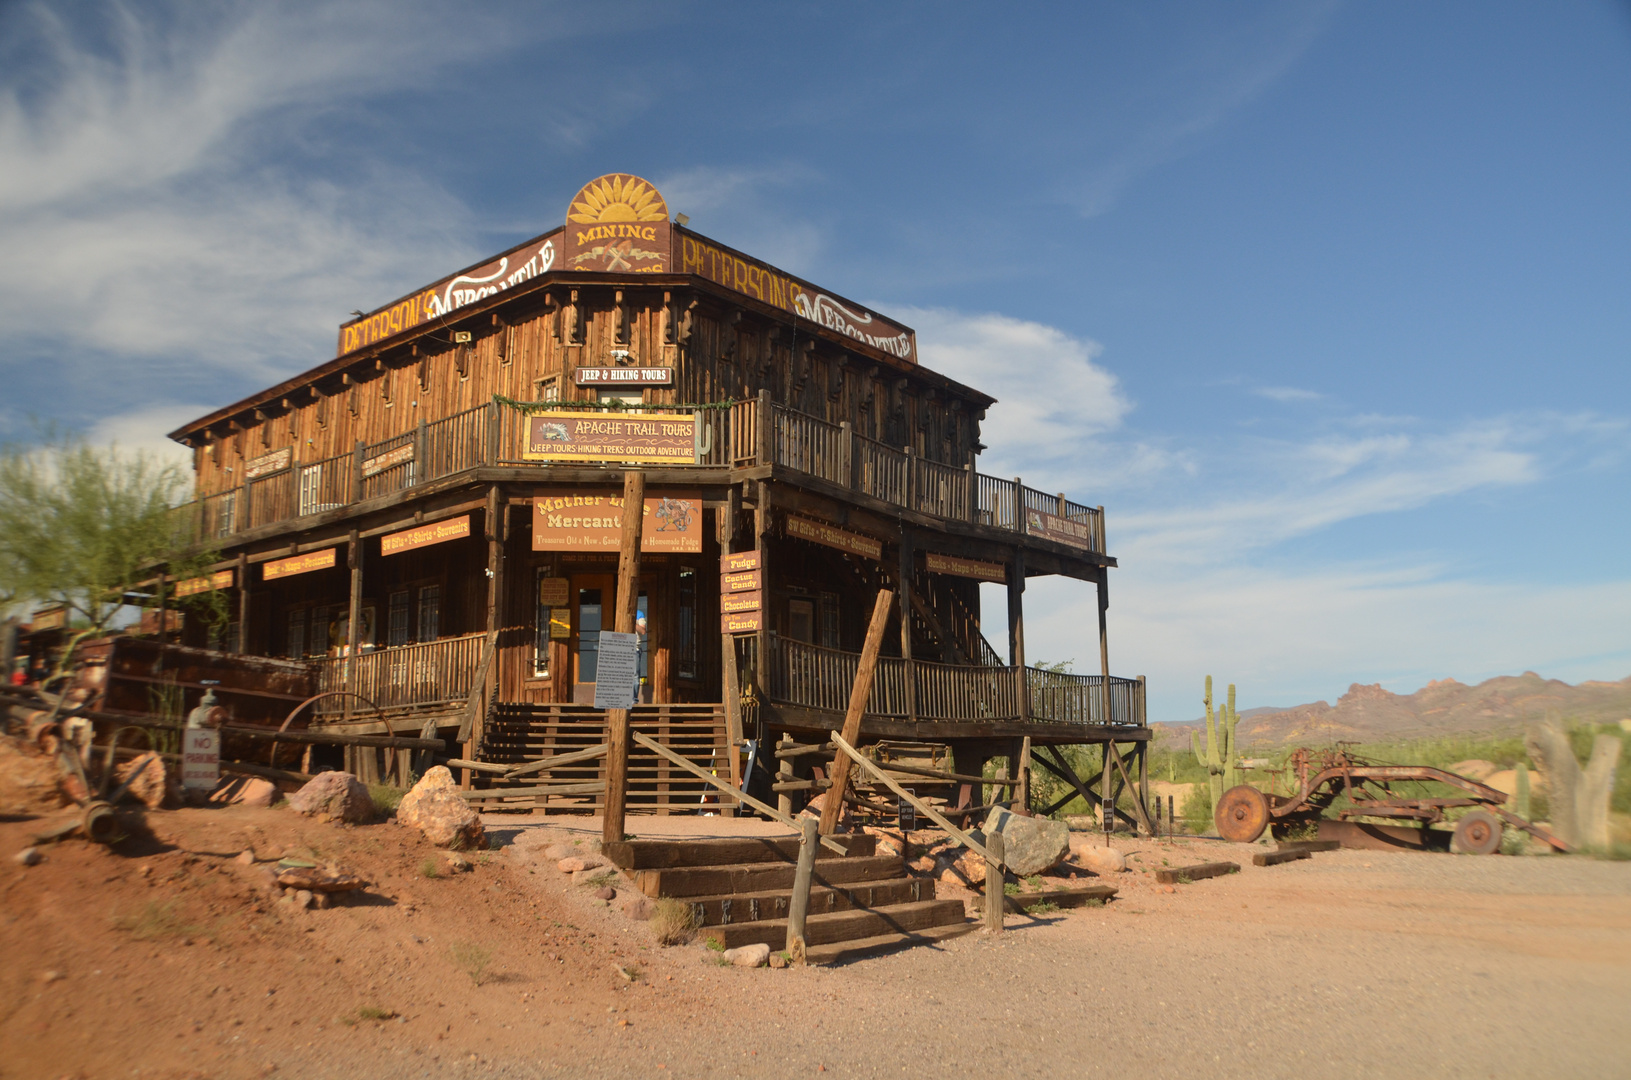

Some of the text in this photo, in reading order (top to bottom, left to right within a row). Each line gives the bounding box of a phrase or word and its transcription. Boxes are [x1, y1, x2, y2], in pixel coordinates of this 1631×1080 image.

[577, 224, 656, 246] MINING
[682, 235, 803, 316] PETERSON'S
[344, 289, 436, 354] PETERSON'S
[581, 369, 666, 382] JEEP & HIKING TOURS
[574, 421, 693, 437] APACHE TRAIL TOURS
[531, 443, 693, 456] JEEP TOURS HIKING TREKS OUTDOOR ADVENTURE
[538, 494, 604, 516] Mother
[547, 514, 622, 528] Mercant
[408, 530, 433, 545] T-Shirts
[437, 521, 469, 539] Souvenirs
[788, 518, 881, 557] SW Gifts T-Shirts Souvenirs
[567, 535, 577, 545] Old
[584, 536, 598, 546] New
[603, 536, 622, 546] Candy
[650, 537, 680, 546] Homemade
[285, 561, 301, 573] Maps
[304, 553, 335, 569] Postcards
[730, 558, 756, 569] Fudge
[927, 557, 1005, 578] Books Maps Postcards
[725, 574, 753, 583] Cactus
[731, 580, 757, 590] Candy
[724, 600, 759, 611] Chocolates
[728, 619, 758, 630] Candy
[193, 737, 211, 749] NO
